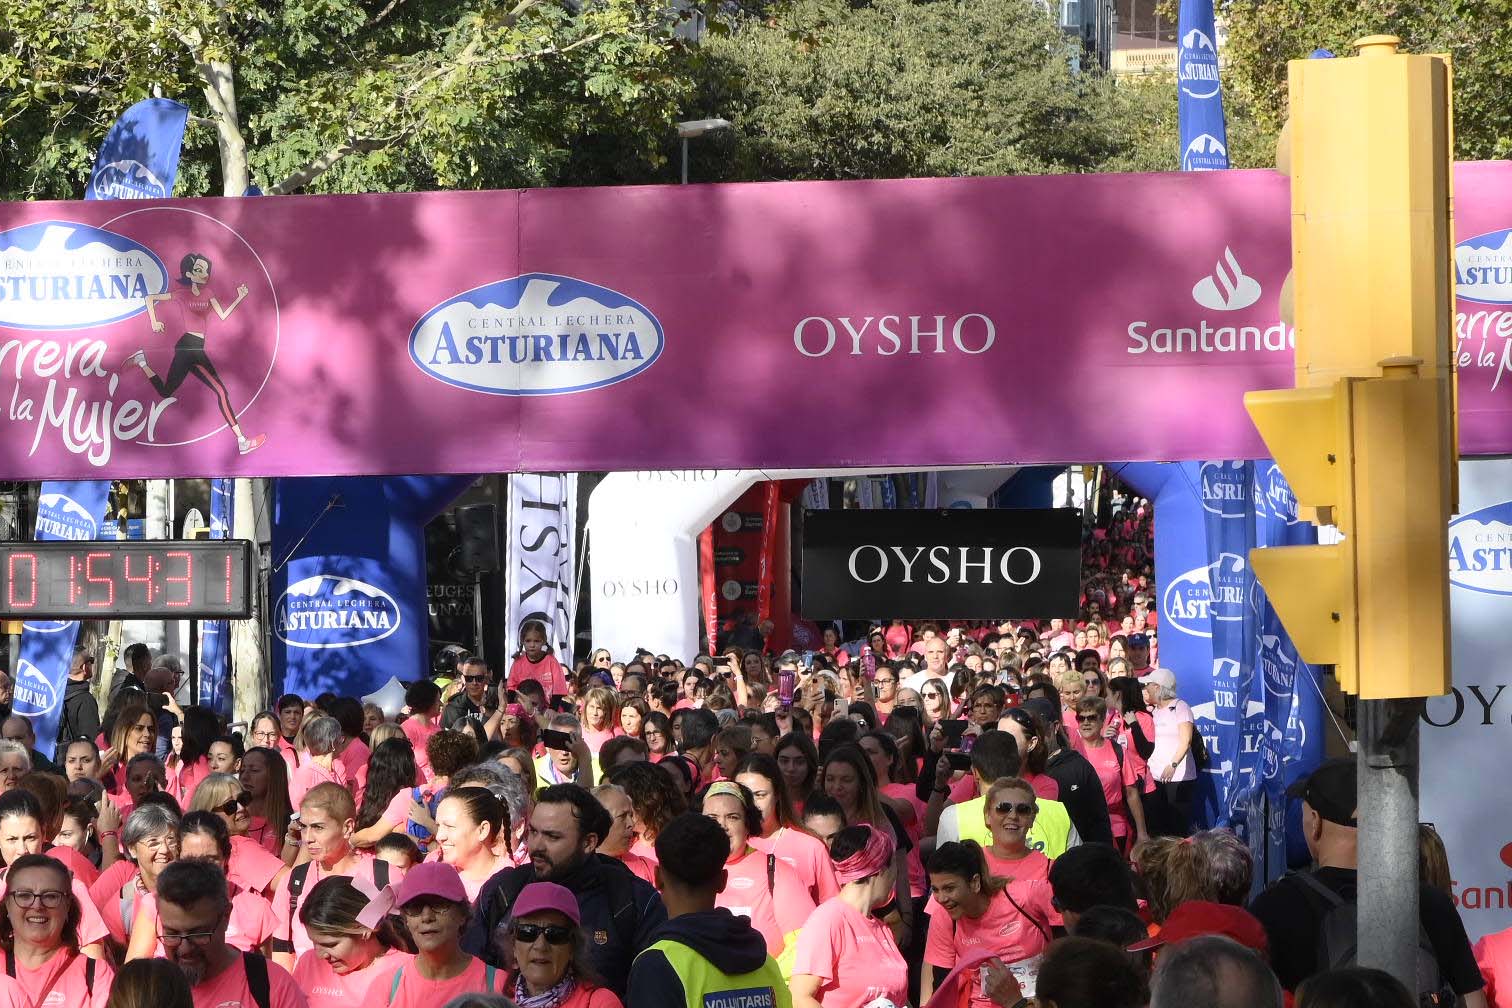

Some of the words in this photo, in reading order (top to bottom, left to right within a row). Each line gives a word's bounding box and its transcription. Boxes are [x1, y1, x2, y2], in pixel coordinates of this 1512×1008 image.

[468, 314, 547, 329] CENTRAL
[555, 312, 635, 327] LECHERA
[793, 313, 997, 357] OYSHO
[429, 320, 645, 366] ASTURIANA
[8, 381, 34, 421] la
[28, 373, 177, 467] Mujer
[8, 552, 232, 607] 01:54:31
[847, 544, 1041, 587] OYSHO
[290, 600, 333, 609] CENTRAL
[337, 599, 387, 608] LECHERA
[602, 577, 679, 598] OYSHO
[277, 604, 392, 633] ASTURIANA
[312, 986, 344, 998] OYSHO
